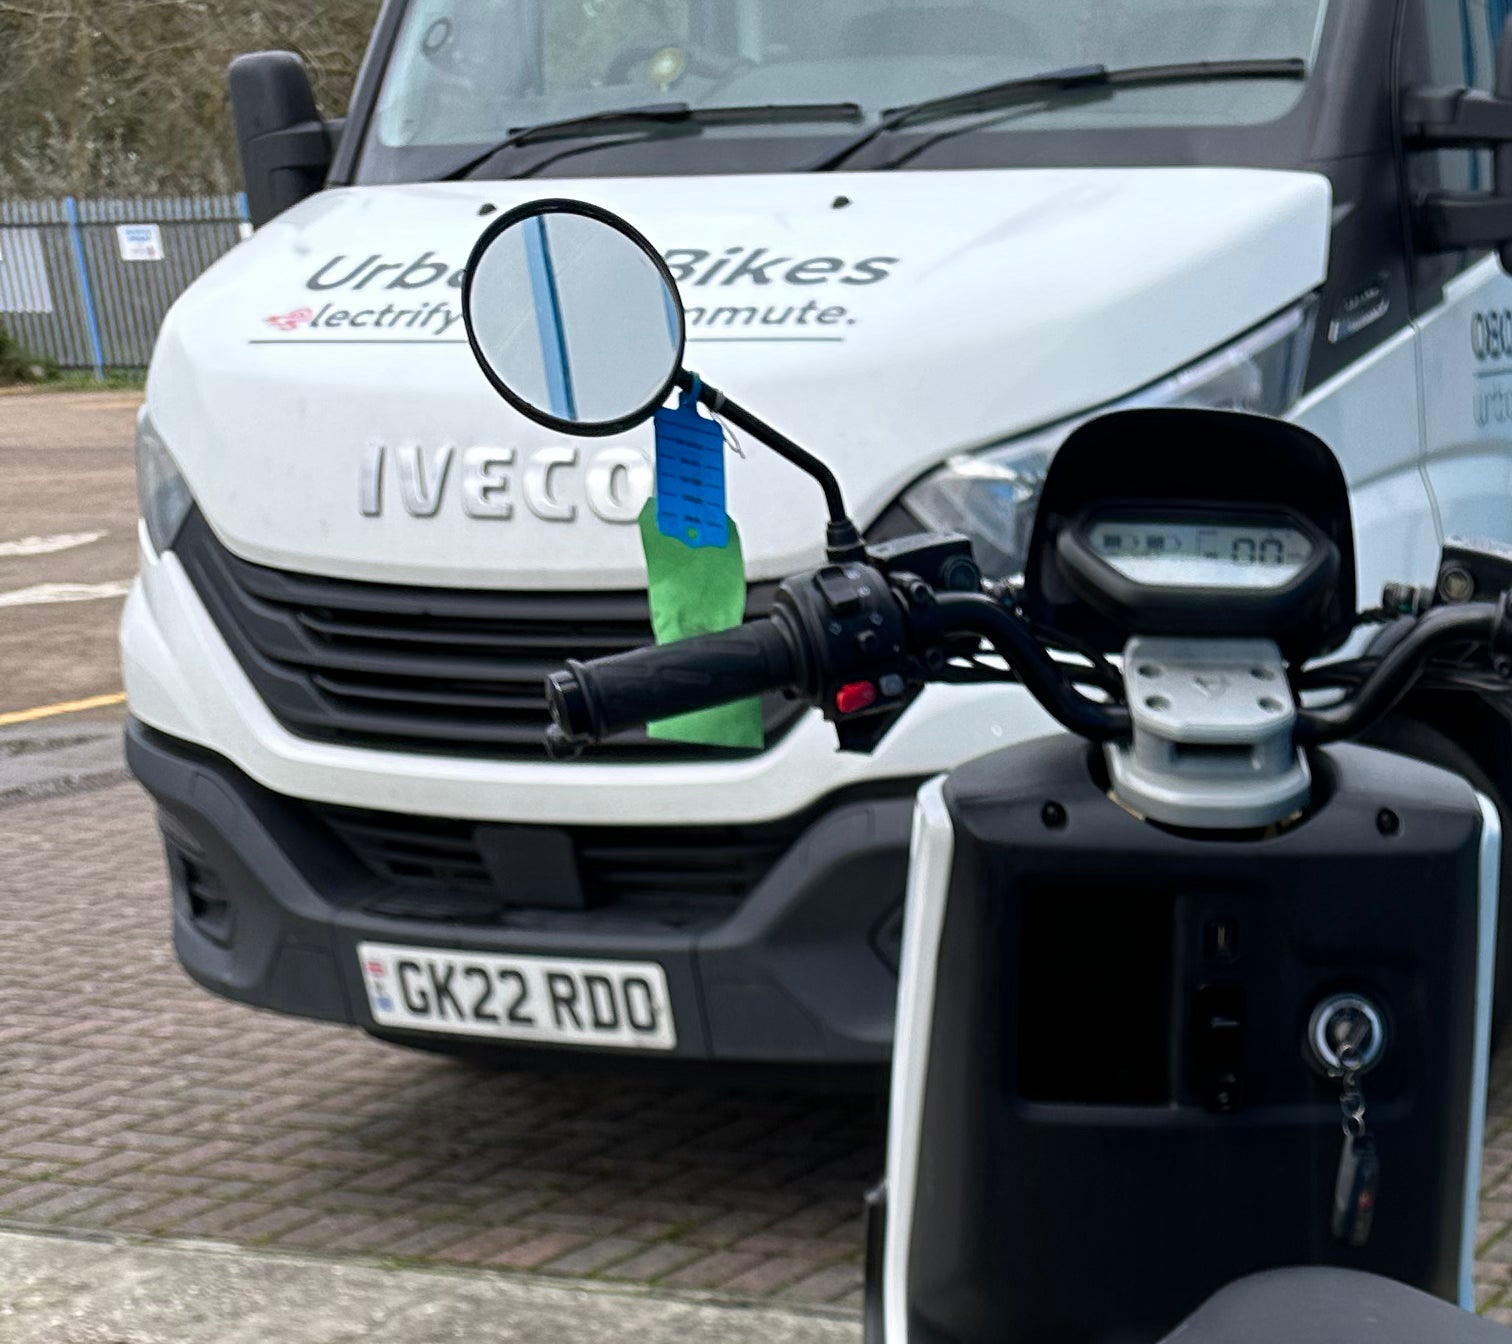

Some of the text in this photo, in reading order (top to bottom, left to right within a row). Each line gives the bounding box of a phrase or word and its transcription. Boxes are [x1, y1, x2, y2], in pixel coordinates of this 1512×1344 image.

[305, 246, 901, 291] Urb Bikes
[358, 446, 654, 525] IVECO
[396, 959, 535, 1028] GK22
